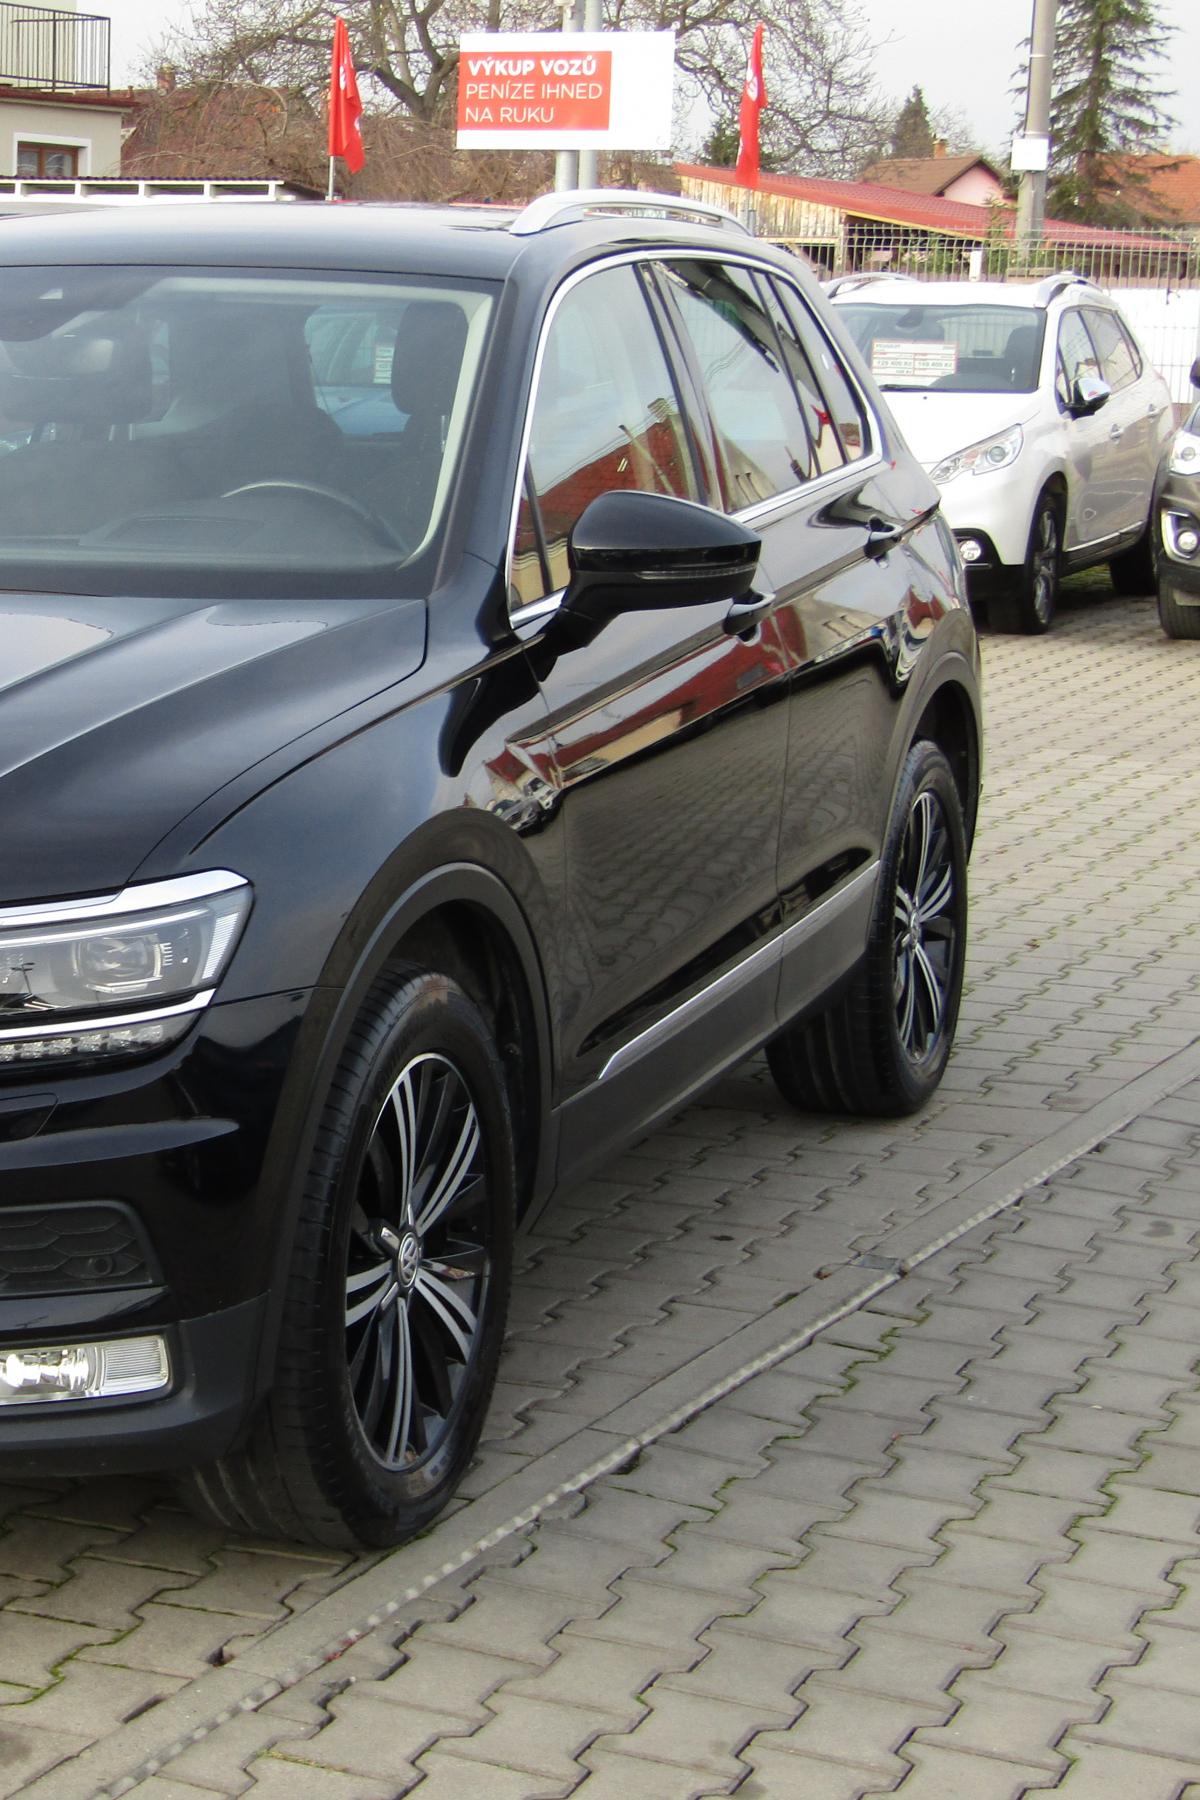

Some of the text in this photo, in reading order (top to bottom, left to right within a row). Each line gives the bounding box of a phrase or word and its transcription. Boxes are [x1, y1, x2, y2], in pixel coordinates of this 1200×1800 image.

[468, 55, 597, 76] VÝKUP VOZŮ
[466, 80, 603, 99] PENÍZE IHNED
[465, 107, 555, 123] NA RUKU
